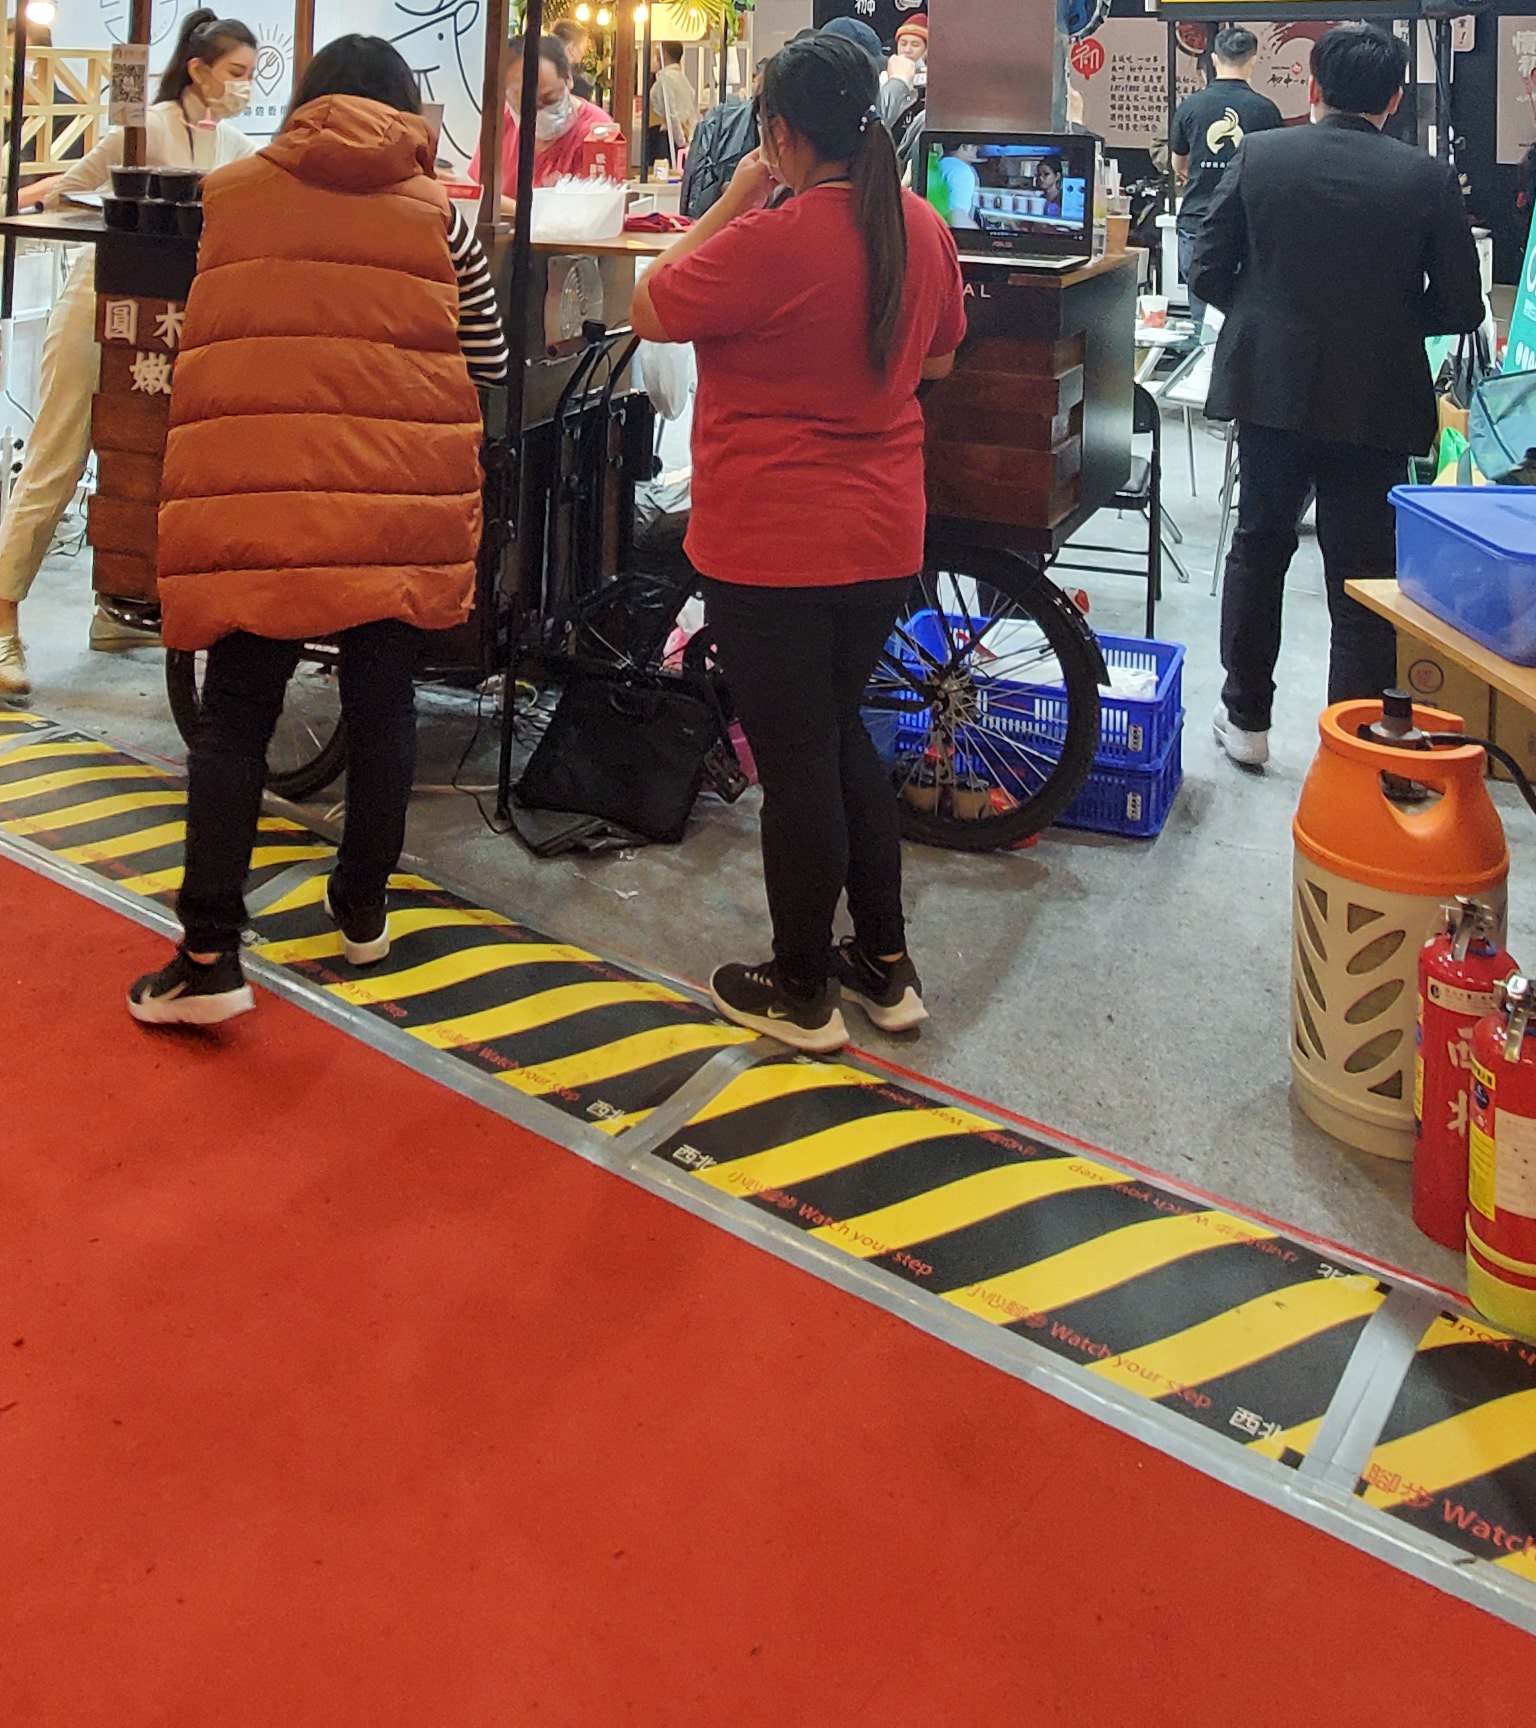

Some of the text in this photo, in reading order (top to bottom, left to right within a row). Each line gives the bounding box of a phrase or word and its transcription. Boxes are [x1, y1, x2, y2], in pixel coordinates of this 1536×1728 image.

[796, 1201, 852, 1237] Watch
[890, 1245, 934, 1277] step
[1048, 1319, 1114, 1362] Watch
[1111, 1353, 1163, 1391] your
[1164, 1375, 1213, 1410] step
